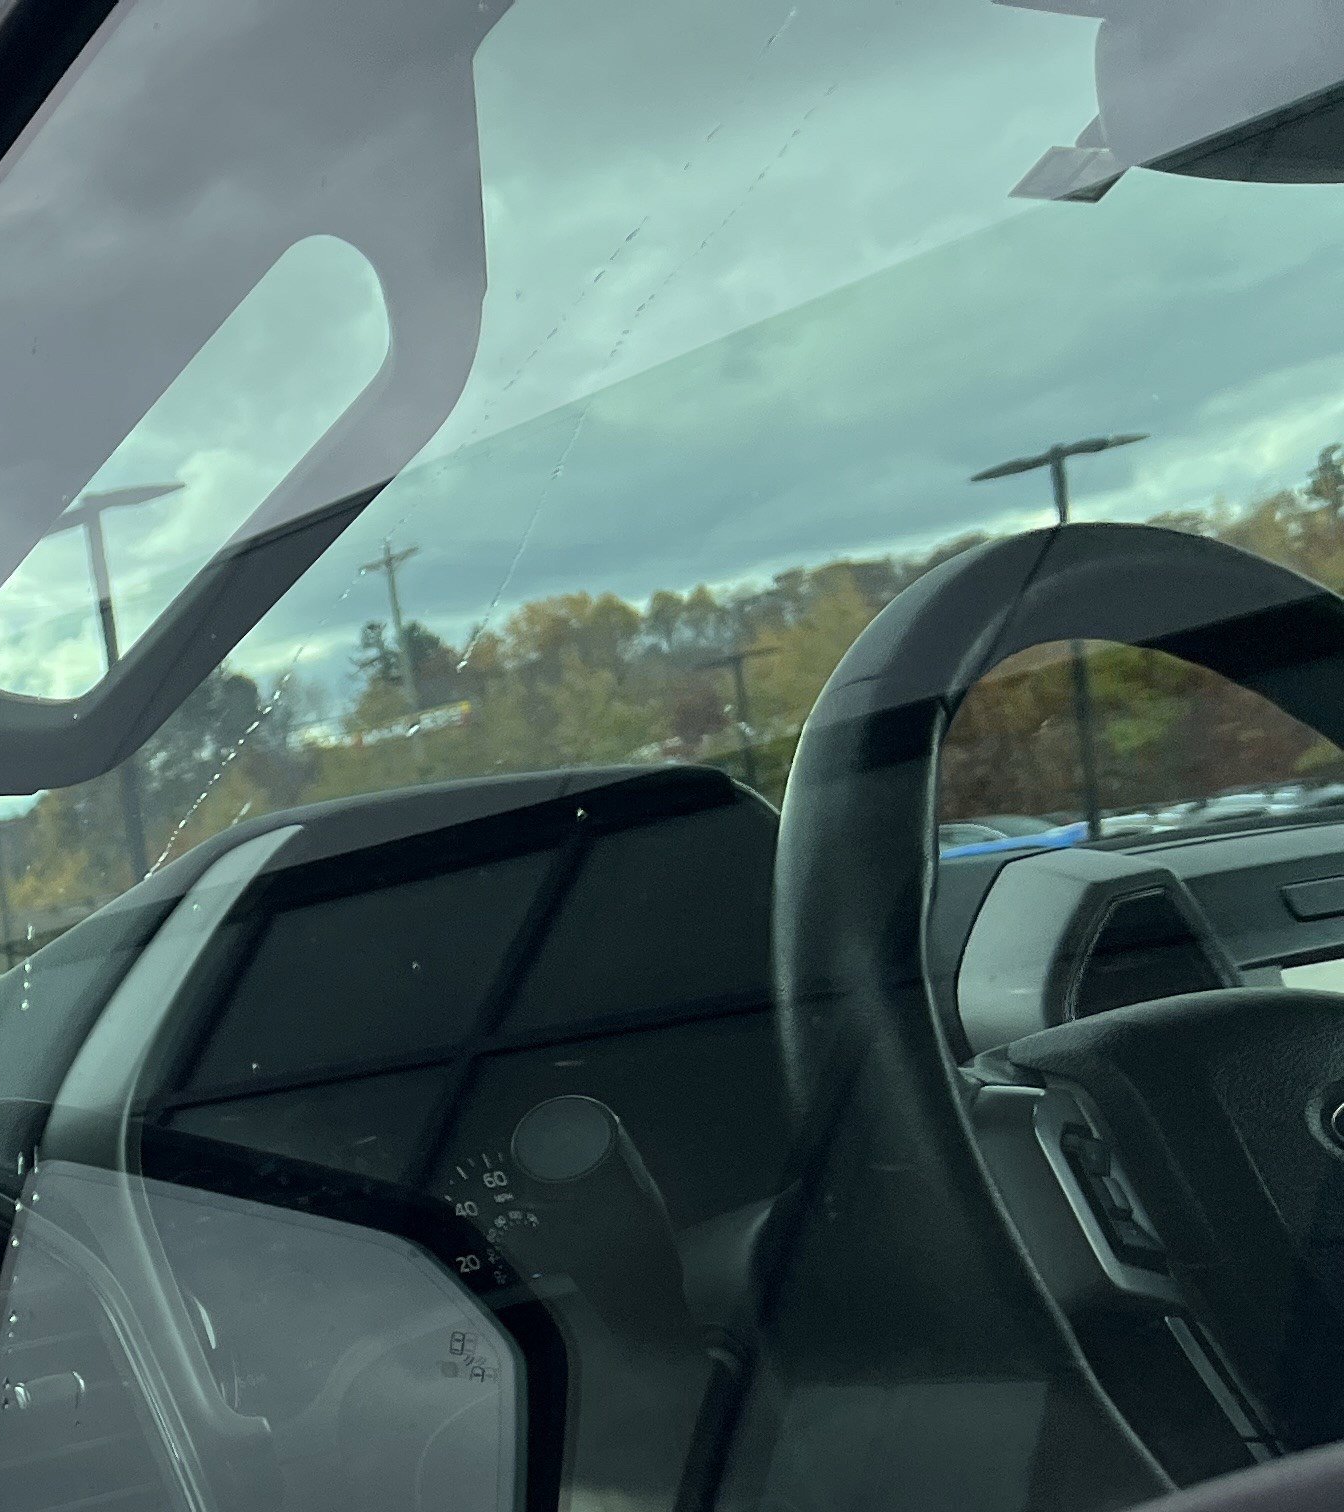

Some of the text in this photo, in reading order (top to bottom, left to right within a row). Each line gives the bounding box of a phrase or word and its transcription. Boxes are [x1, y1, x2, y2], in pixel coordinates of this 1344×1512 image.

[482, 1170, 508, 1189] 60
[455, 1200, 479, 1217] 40
[455, 1254, 481, 1274] 20
